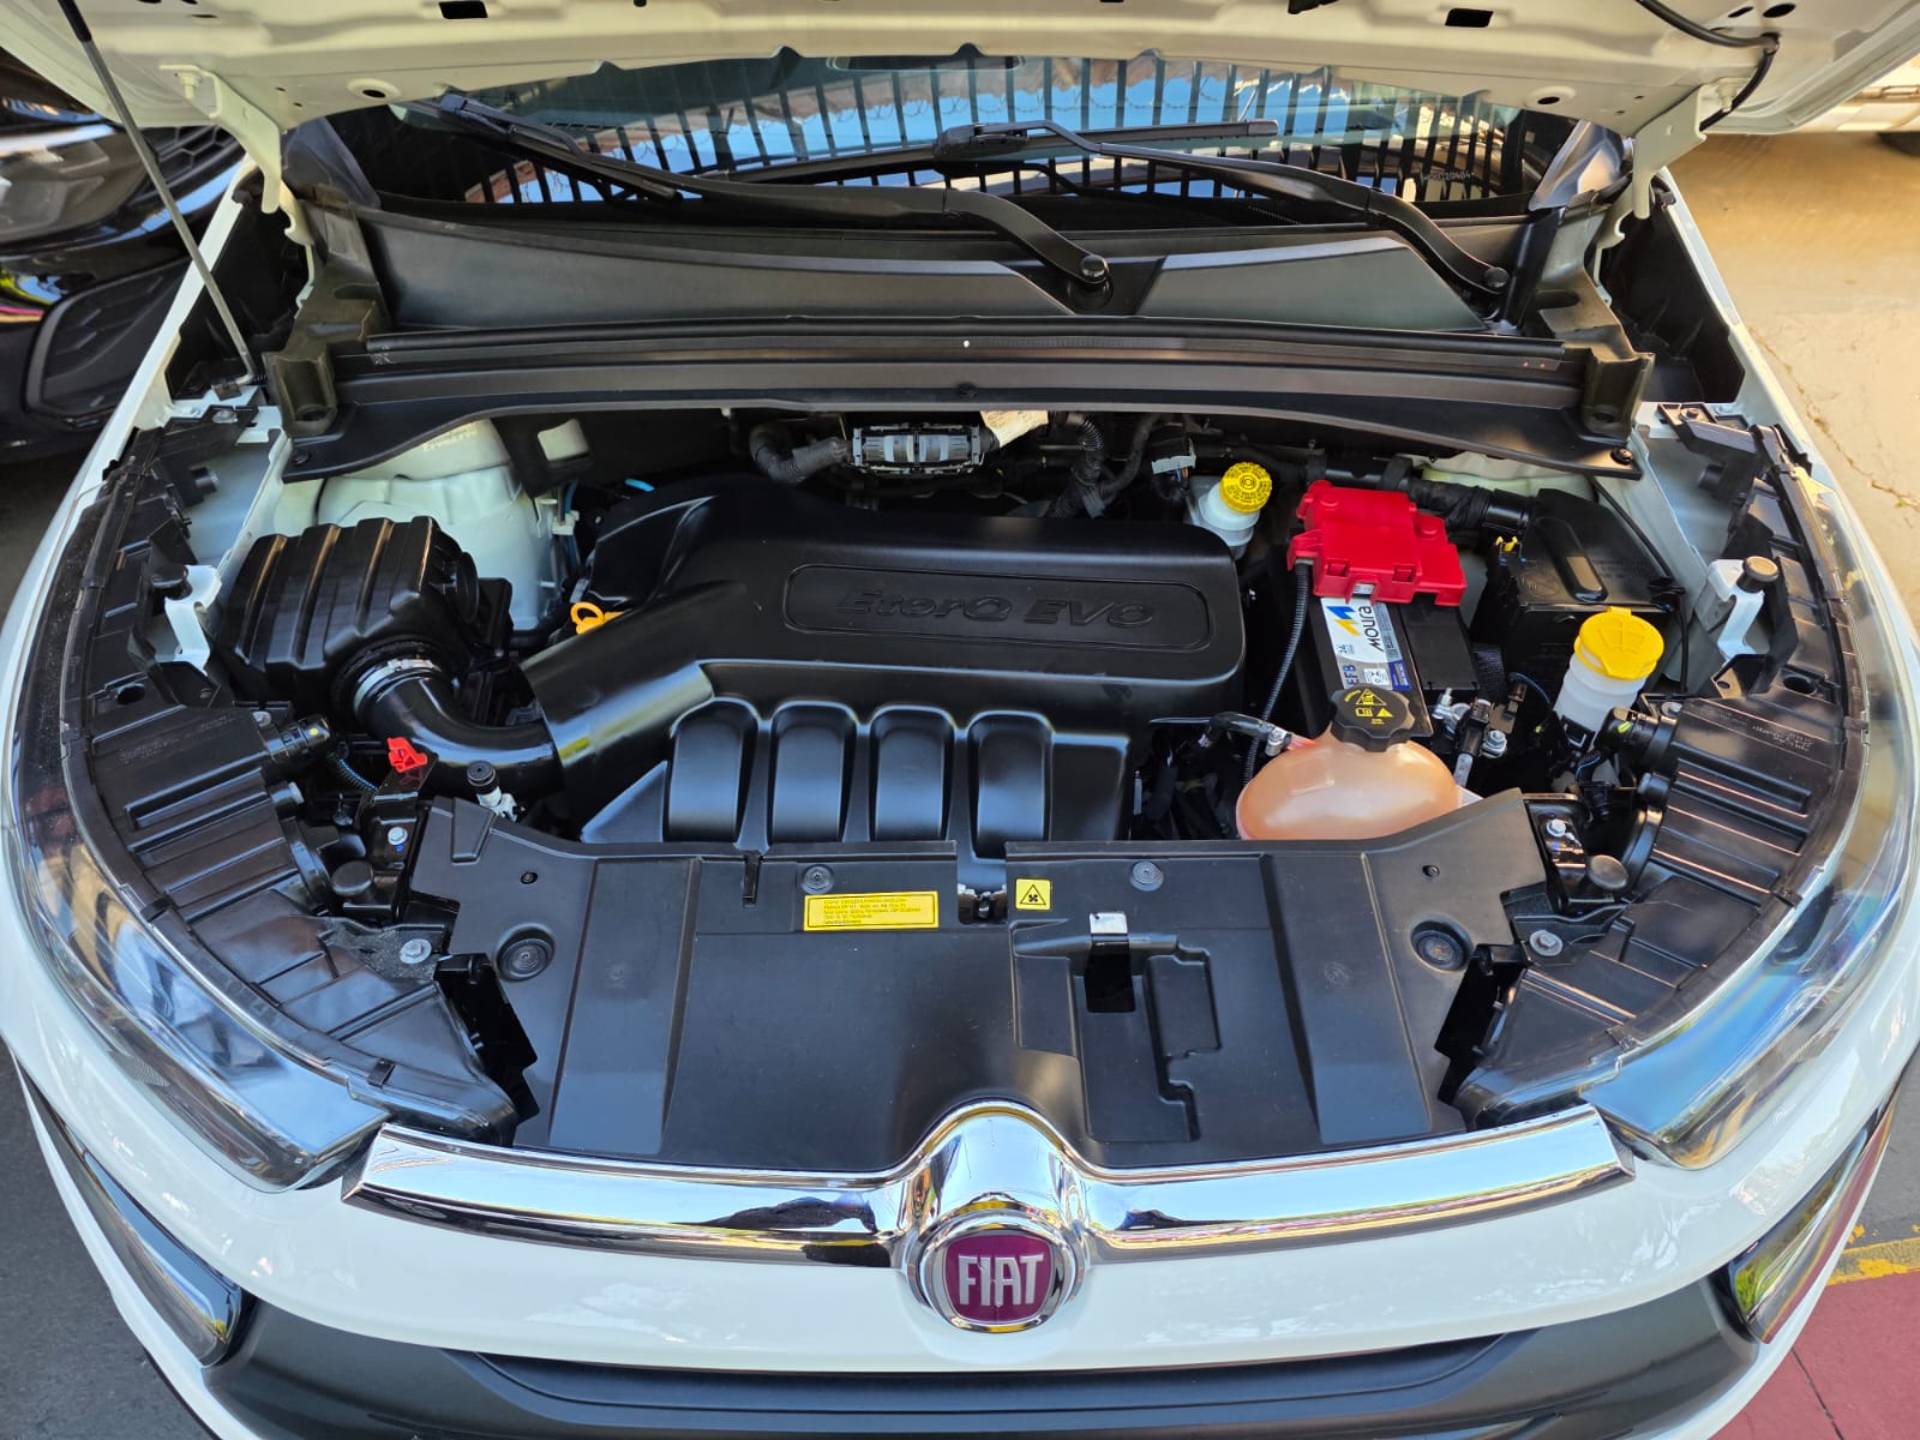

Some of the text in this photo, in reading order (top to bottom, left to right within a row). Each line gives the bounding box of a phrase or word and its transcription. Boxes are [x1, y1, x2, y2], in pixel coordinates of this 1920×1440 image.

[1024, 598, 1154, 628] EVO
[1343, 664, 1359, 686] EFB
[958, 1254, 1044, 1307] FIAT
